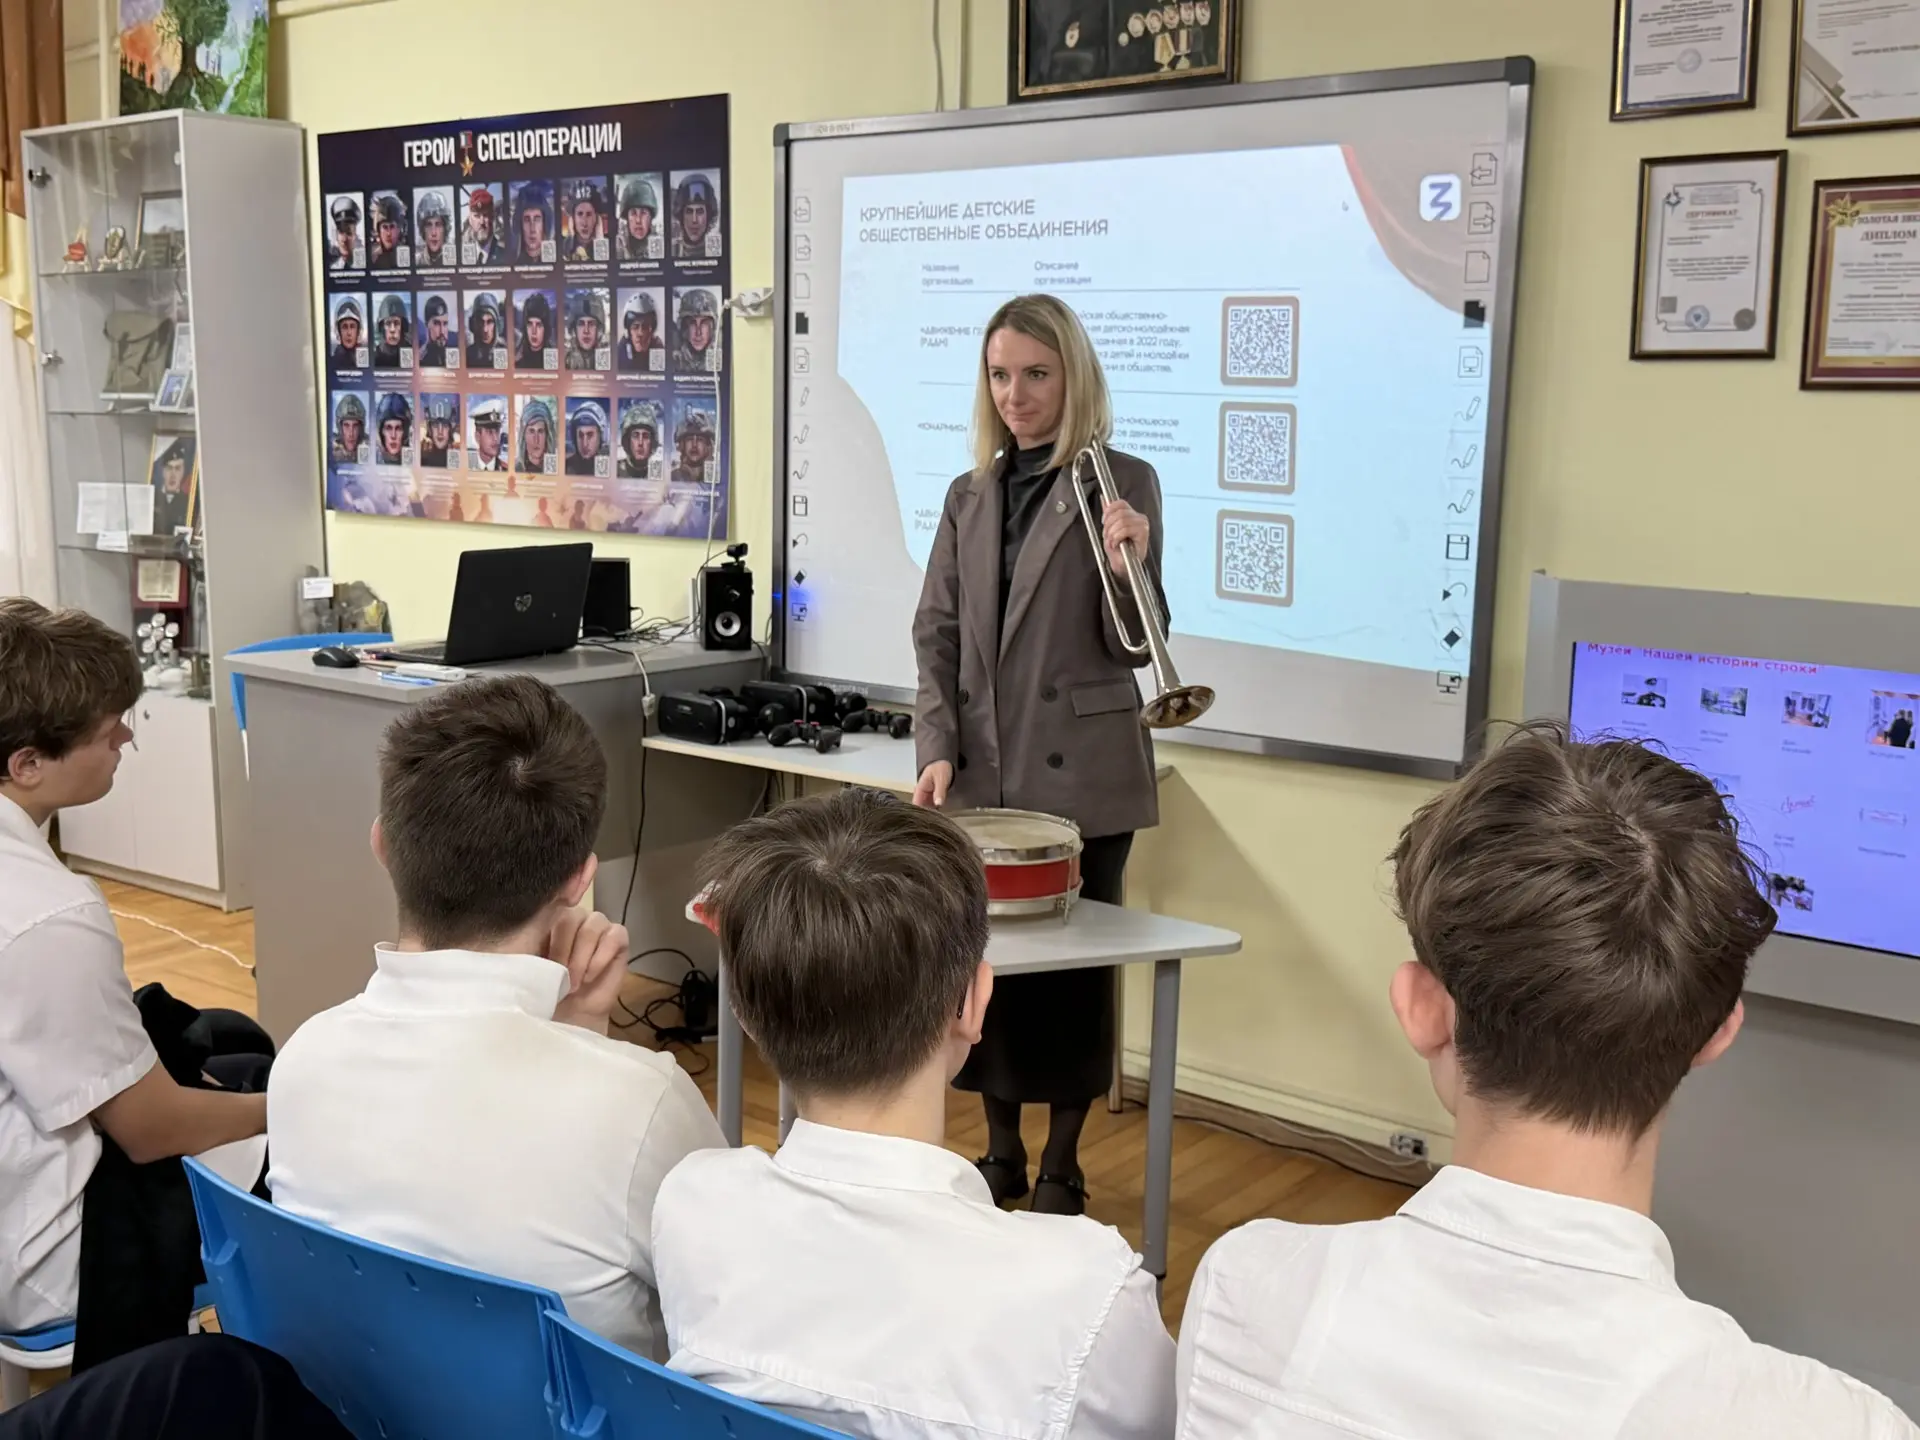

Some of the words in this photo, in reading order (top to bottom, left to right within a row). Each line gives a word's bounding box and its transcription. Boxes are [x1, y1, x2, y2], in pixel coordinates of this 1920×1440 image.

[403, 136, 456, 168] ГЕРОИ
[477, 122, 622, 163] СПЕЦОПЕРАЦИИ
[860, 201, 959, 222] КРУПНЕЙШИЕ
[962, 199, 1036, 220] ДЕТСКИЕ
[860, 224, 980, 244] ОБЩЕСТВЕННЫЕ
[985, 219, 1109, 241] ОБЪЕДИНЕНИЯ
[1860, 229, 1918, 241] ДИПЛОМ
[1136, 336, 1158, 347] 2022
[1698, 655, 1759, 669] истории
